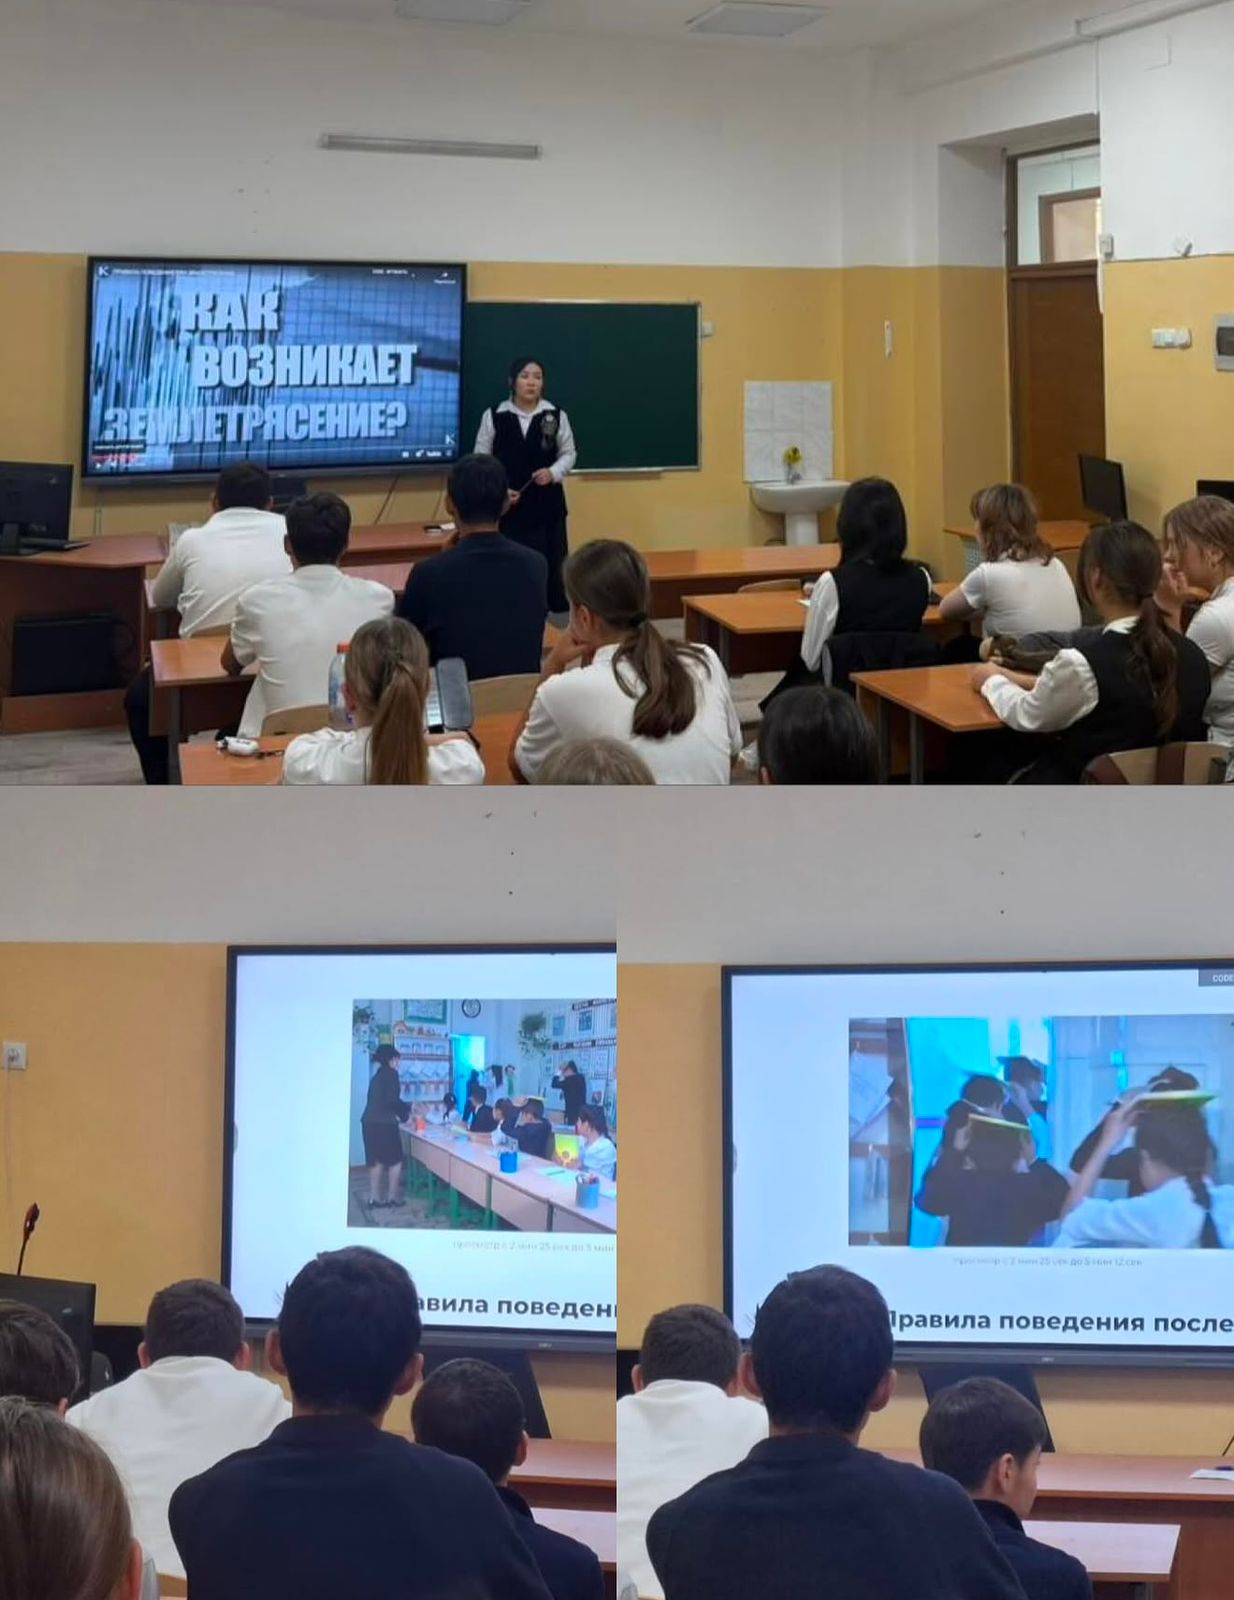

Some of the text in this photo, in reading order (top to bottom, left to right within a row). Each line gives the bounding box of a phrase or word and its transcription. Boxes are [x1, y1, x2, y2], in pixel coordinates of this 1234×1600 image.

[182, 290, 280, 330] КАК
[196, 344, 418, 387] ВОЗНИКАЕТ
[103, 402, 407, 444] ЗЕМЛЕТРЯСЕНИЕ?
[416, 1296, 617, 1319] авила поведен
[1000, 1314, 1145, 1333] поведения
[1154, 1317, 1234, 1333] после
